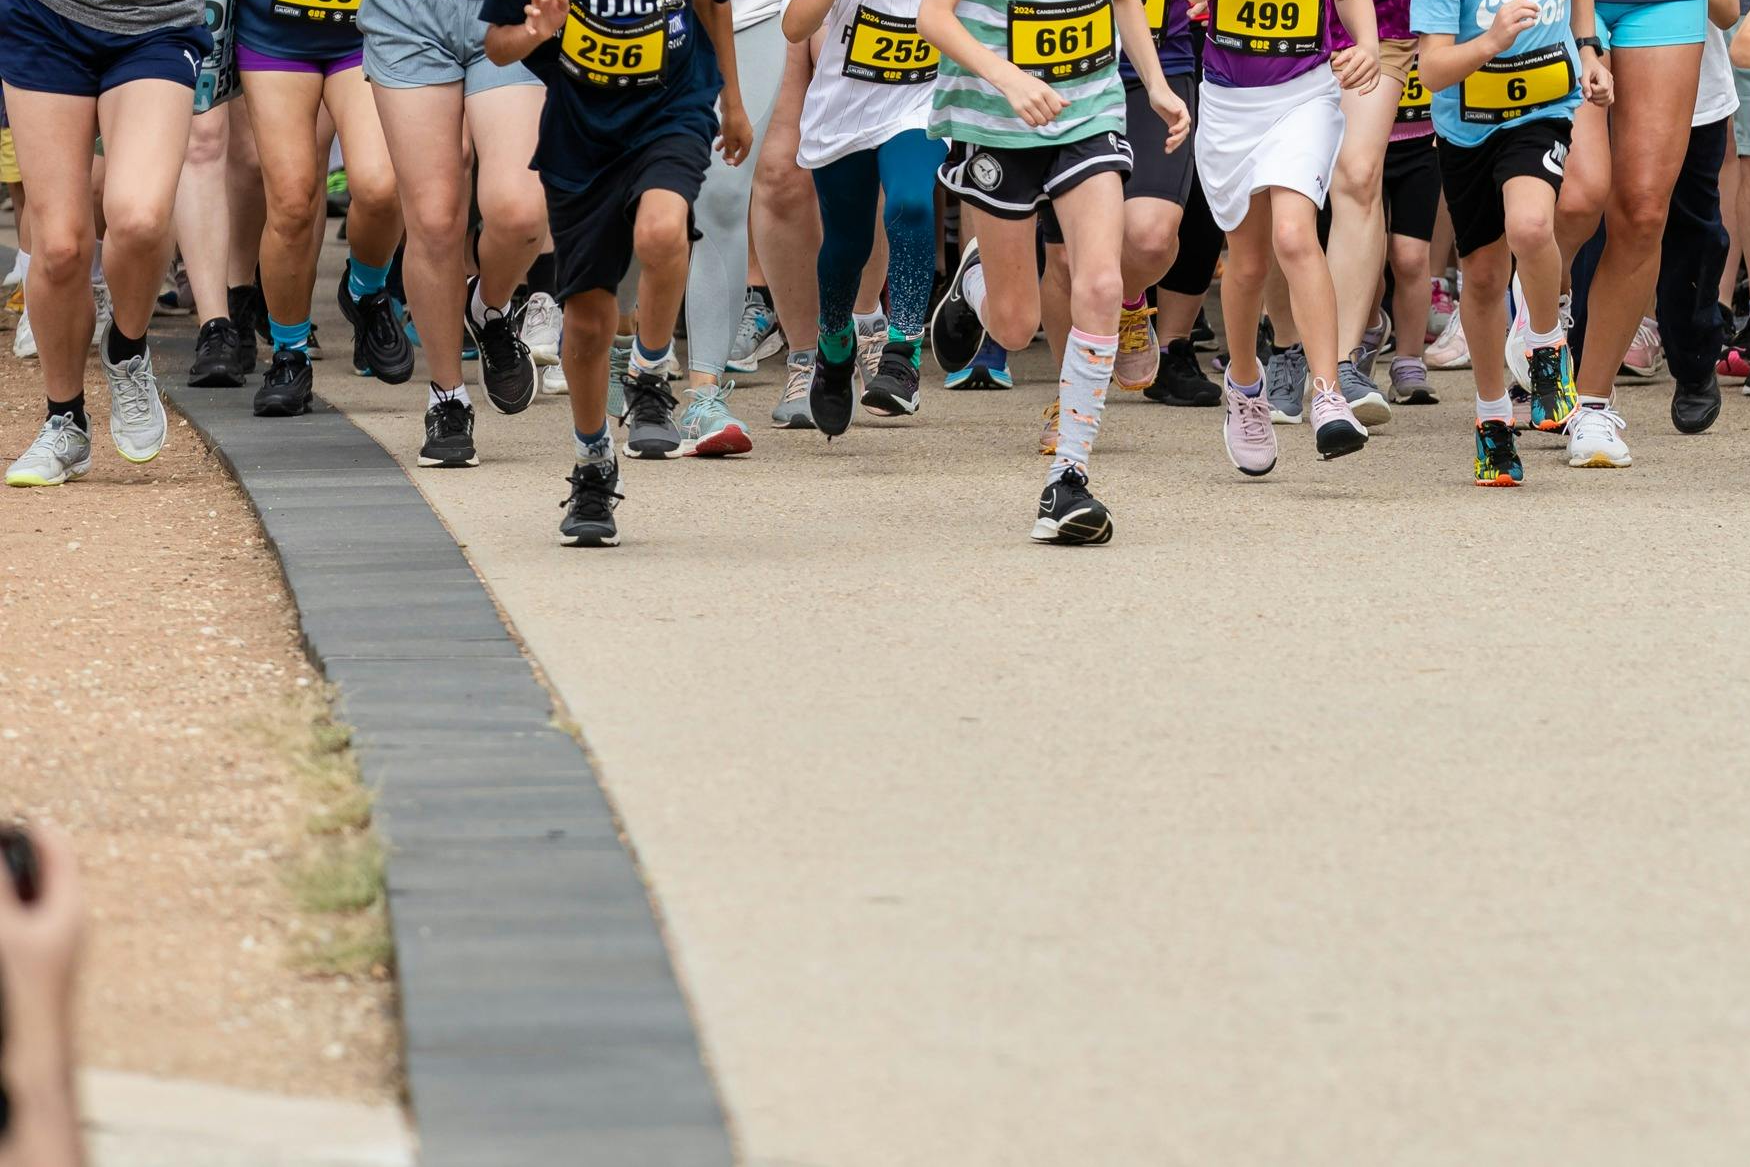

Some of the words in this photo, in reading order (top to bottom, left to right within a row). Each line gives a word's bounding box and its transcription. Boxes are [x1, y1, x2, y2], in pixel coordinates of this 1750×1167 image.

[860, 10, 880, 24] 2024
[880, 19, 907, 29] CANBERRA
[1013, 5, 1035, 15] 2024
[1035, 7, 1067, 16] CANBERRA
[1066, 6, 1078, 14] DAY
[1077, 1, 1096, 12] APPEAL
[1236, 0, 1300, 31] 499
[871, 36, 931, 64] 255
[1035, 20, 1093, 57] 661
[576, 34, 643, 69] 256
[1525, 55, 1544, 65] APPEAL
[1543, 53, 1554, 61] FUN
[1401, 78, 1423, 100] 5
[1507, 77, 1528, 102] 6
